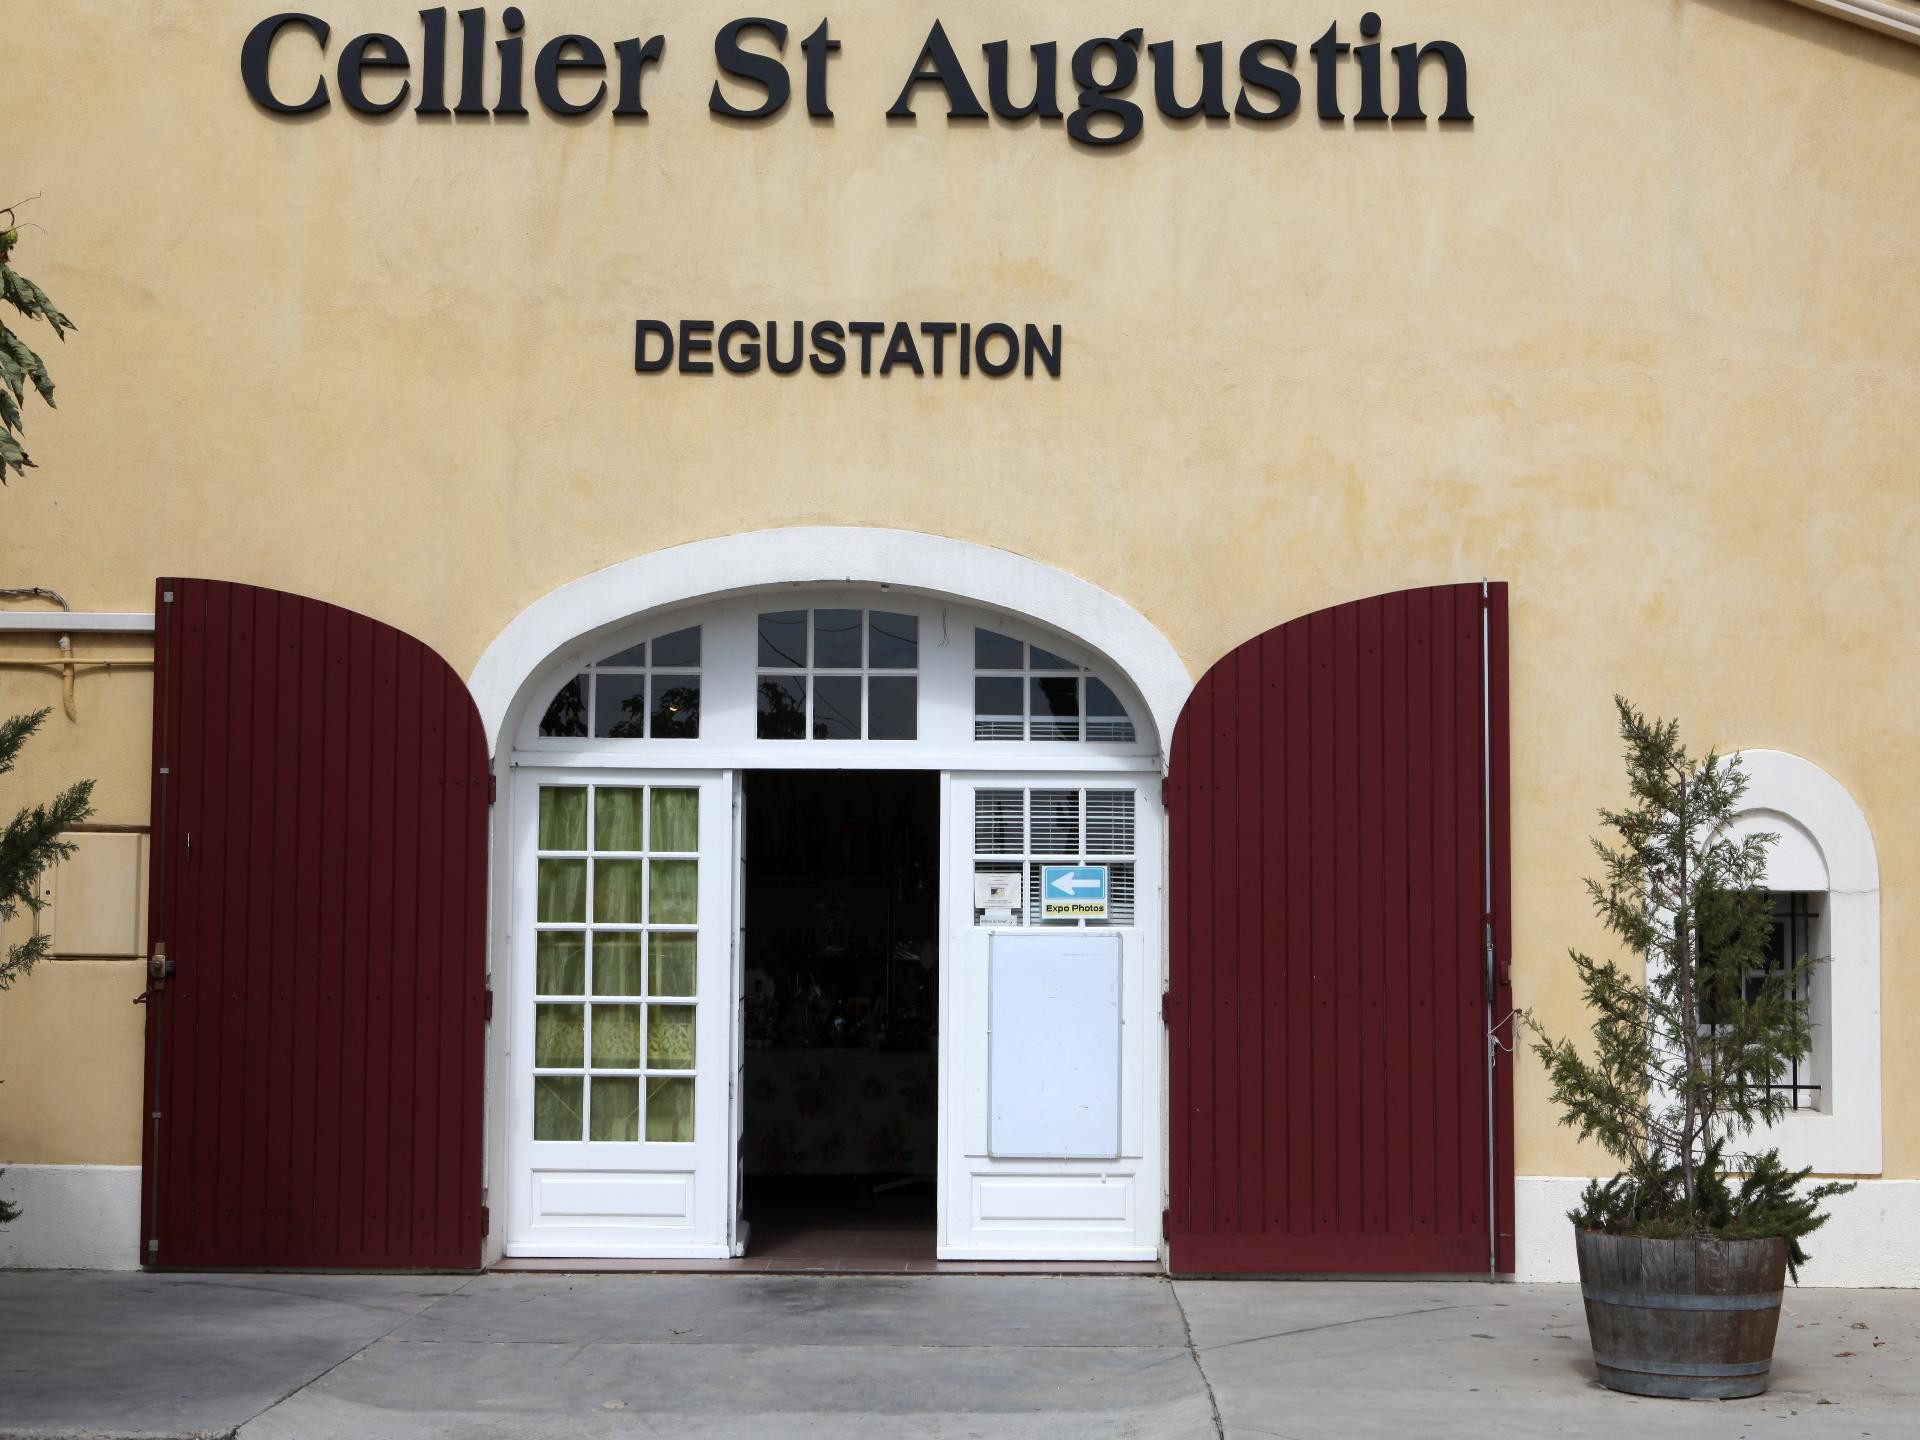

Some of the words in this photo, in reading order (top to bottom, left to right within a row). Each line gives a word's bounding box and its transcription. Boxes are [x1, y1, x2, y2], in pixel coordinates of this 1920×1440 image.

[240, 6, 665, 120] Cellier
[708, 16, 841, 121] St
[885, 11, 1475, 148] Augustin
[634, 319, 1062, 377] DEGUSTATION
[1046, 904, 1070, 913] Expo
[1072, 904, 1104, 912] Photos
